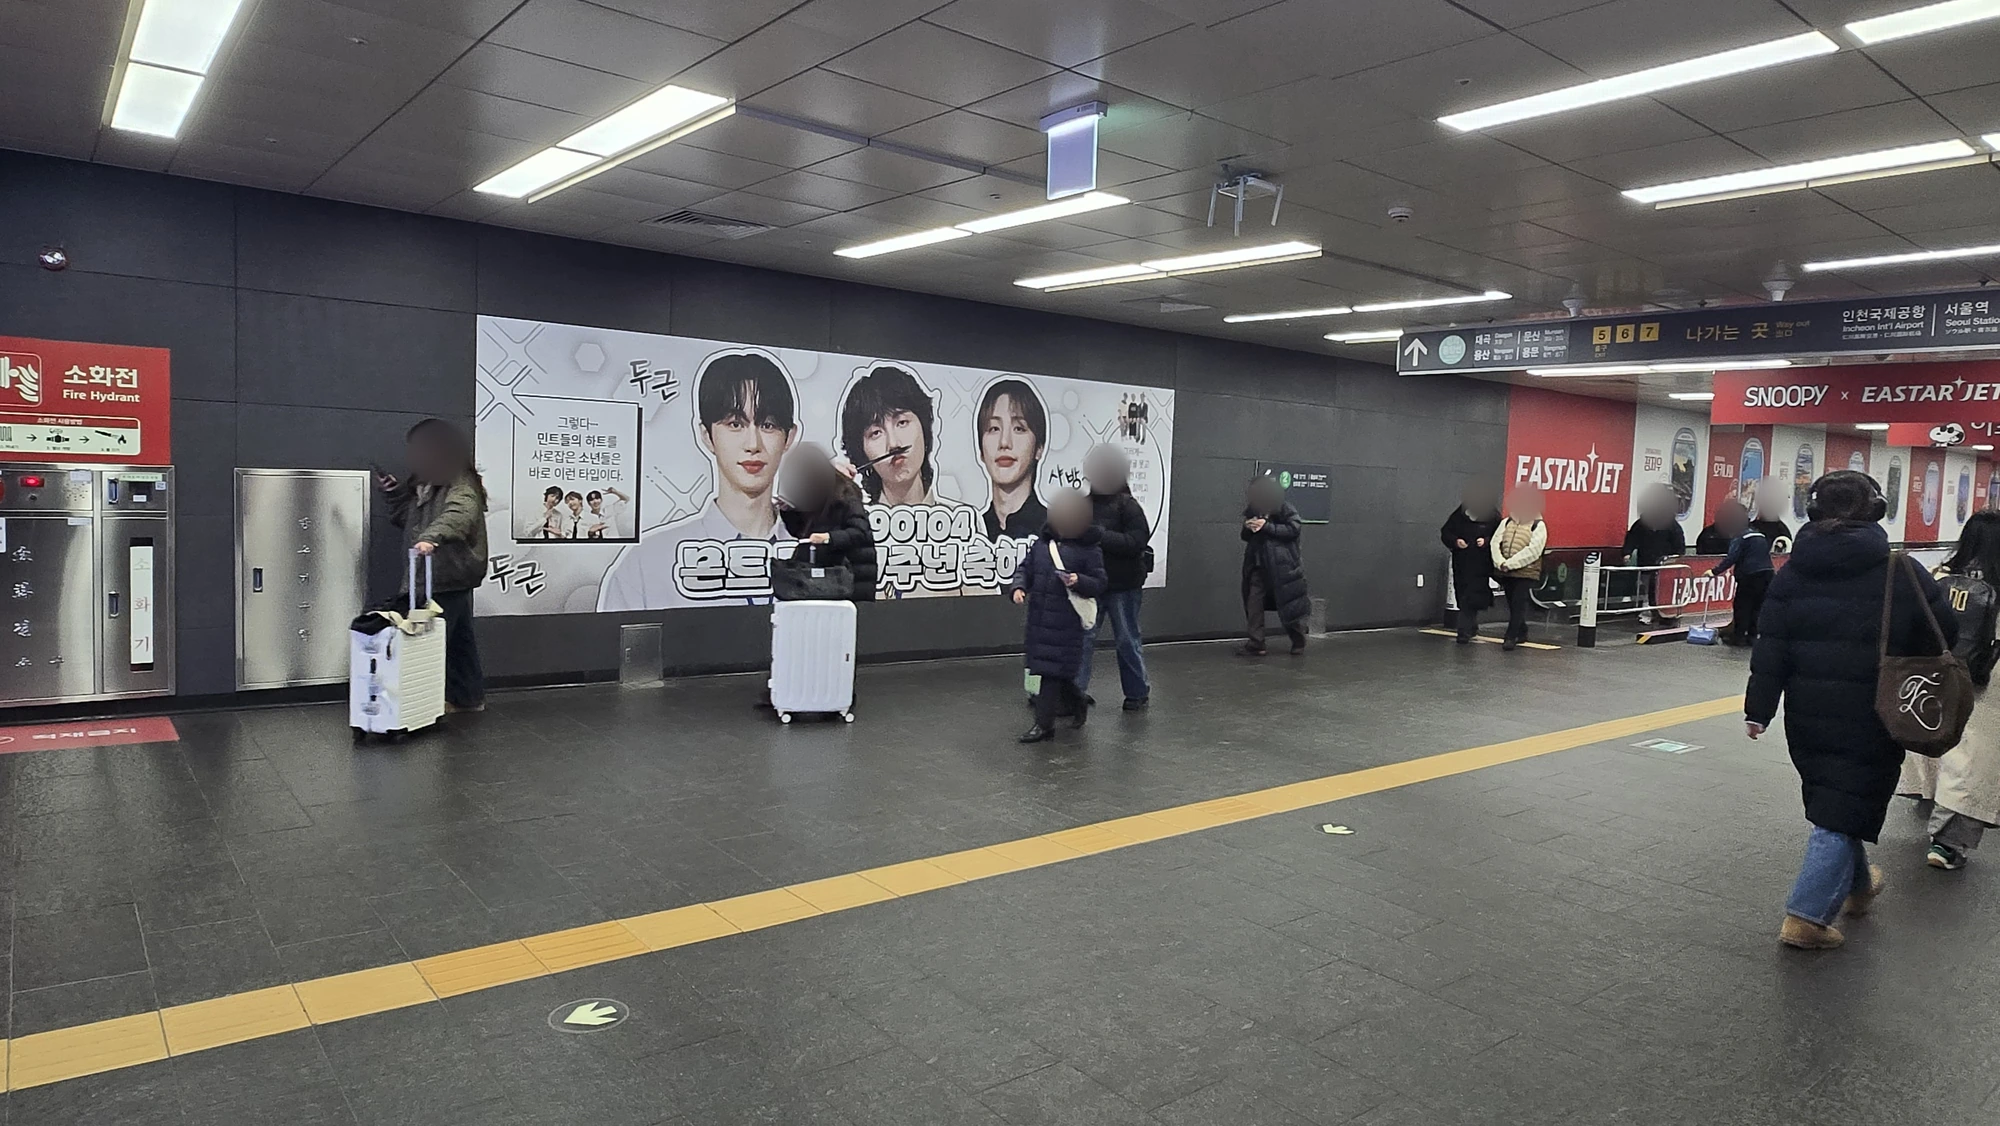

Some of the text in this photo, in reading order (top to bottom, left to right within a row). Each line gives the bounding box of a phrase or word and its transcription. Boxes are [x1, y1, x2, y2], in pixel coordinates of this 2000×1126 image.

[1842, 305, 1926, 323] 인천국제공항
[1945, 301, 1989, 316] 서울역
[1842, 320, 1924, 332] Incheon Int'l Airport
[1945, 318, 1971, 327] Seoul
[1475, 333, 1491, 345] 대곡
[1598, 327, 1654, 340] 5 6 7
[1686, 322, 1769, 342] 나가는 곳
[1474, 349, 1491, 361] 용산
[1522, 346, 1540, 358] 용문
[63, 365, 138, 388] 소화전
[629, 360, 680, 401] 두근
[63, 389, 140, 403] Fire Hydrant
[1743, 385, 1829, 407] SNOOPY
[1861, 384, 1954, 403] EASTAR
[1960, 383, 2000, 401] JET
[537, 432, 617, 448] 민트들의 하트를
[532, 450, 621, 466] 사로잡은 소년들은
[528, 466, 624, 481] 바로 이런 타입이다.
[1516, 455, 1589, 493] EASTAR
[1591, 461, 1624, 494] JET
[489, 554, 546, 595] 두근
[133, 557, 151, 652] 소화기
